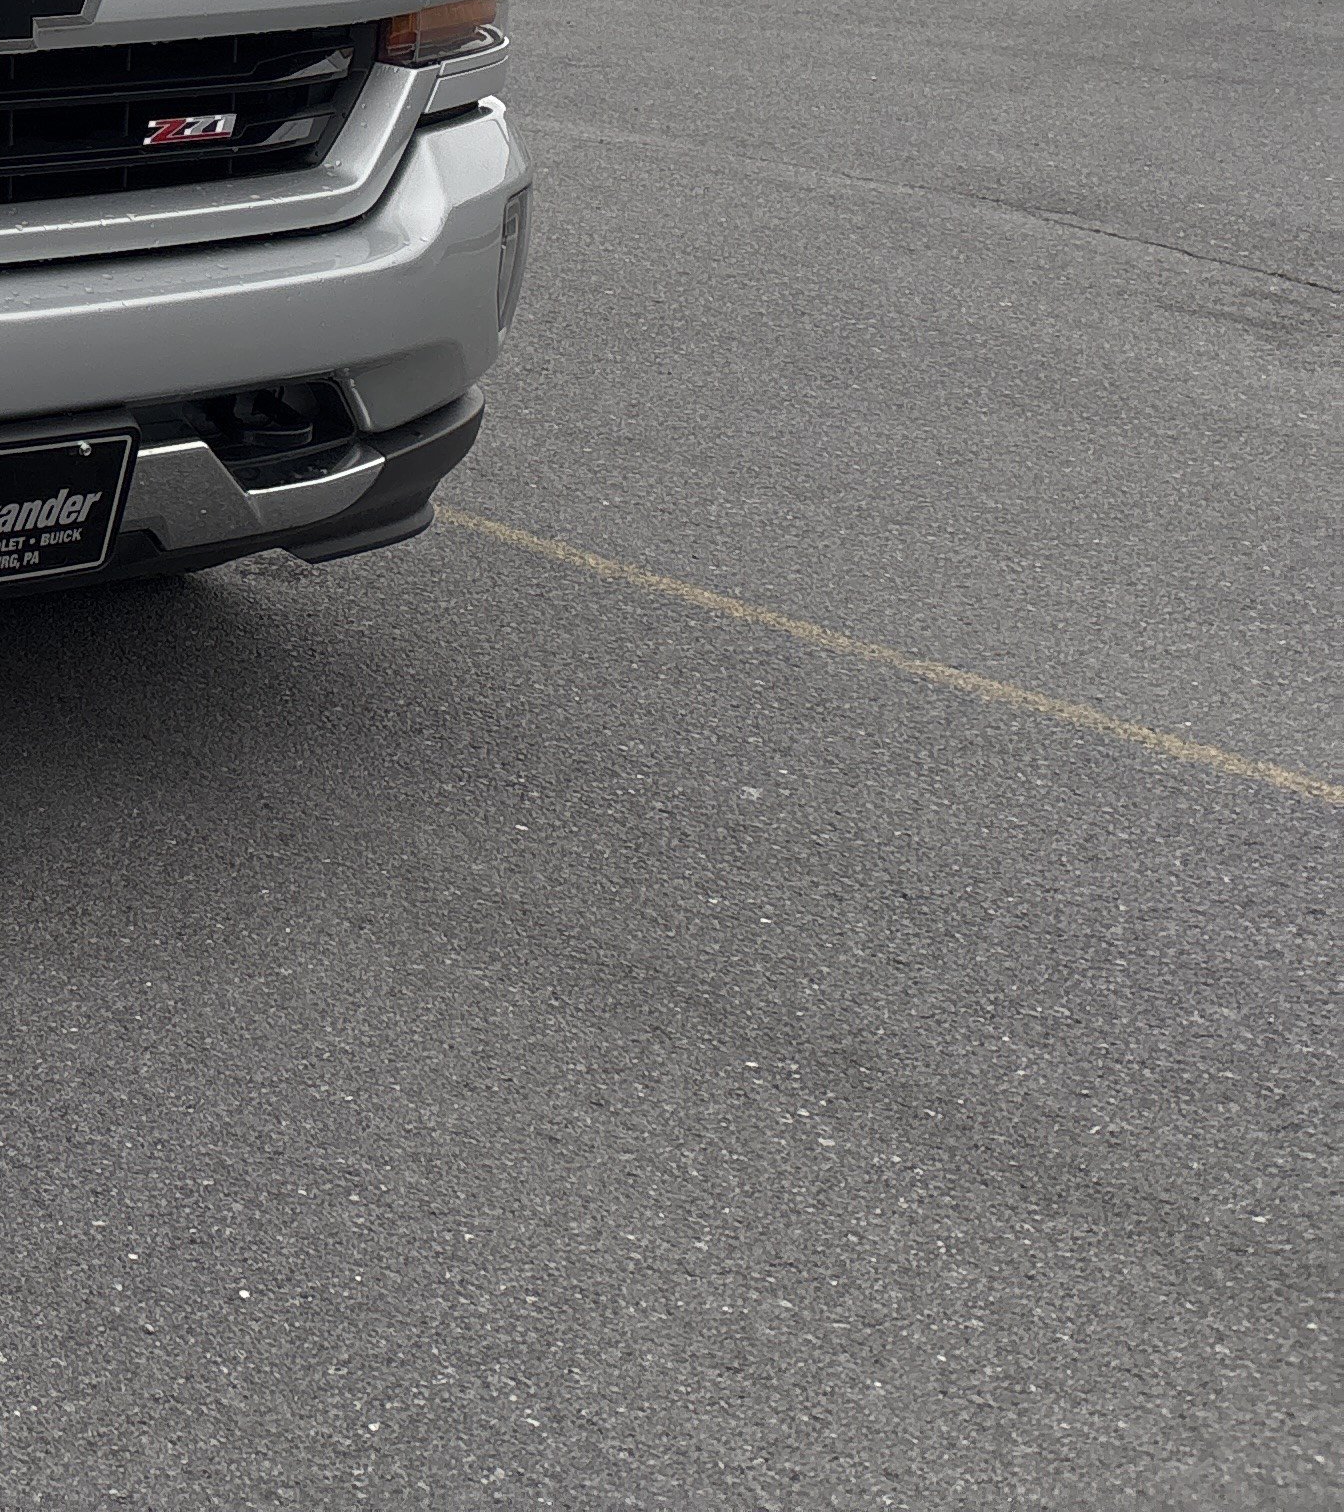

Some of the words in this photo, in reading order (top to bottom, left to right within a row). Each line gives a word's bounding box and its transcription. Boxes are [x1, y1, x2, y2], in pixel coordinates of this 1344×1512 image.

[143, 113, 237, 145] Z71
[40, 527, 83, 547] BUICK
[23, 550, 40, 566] PA
